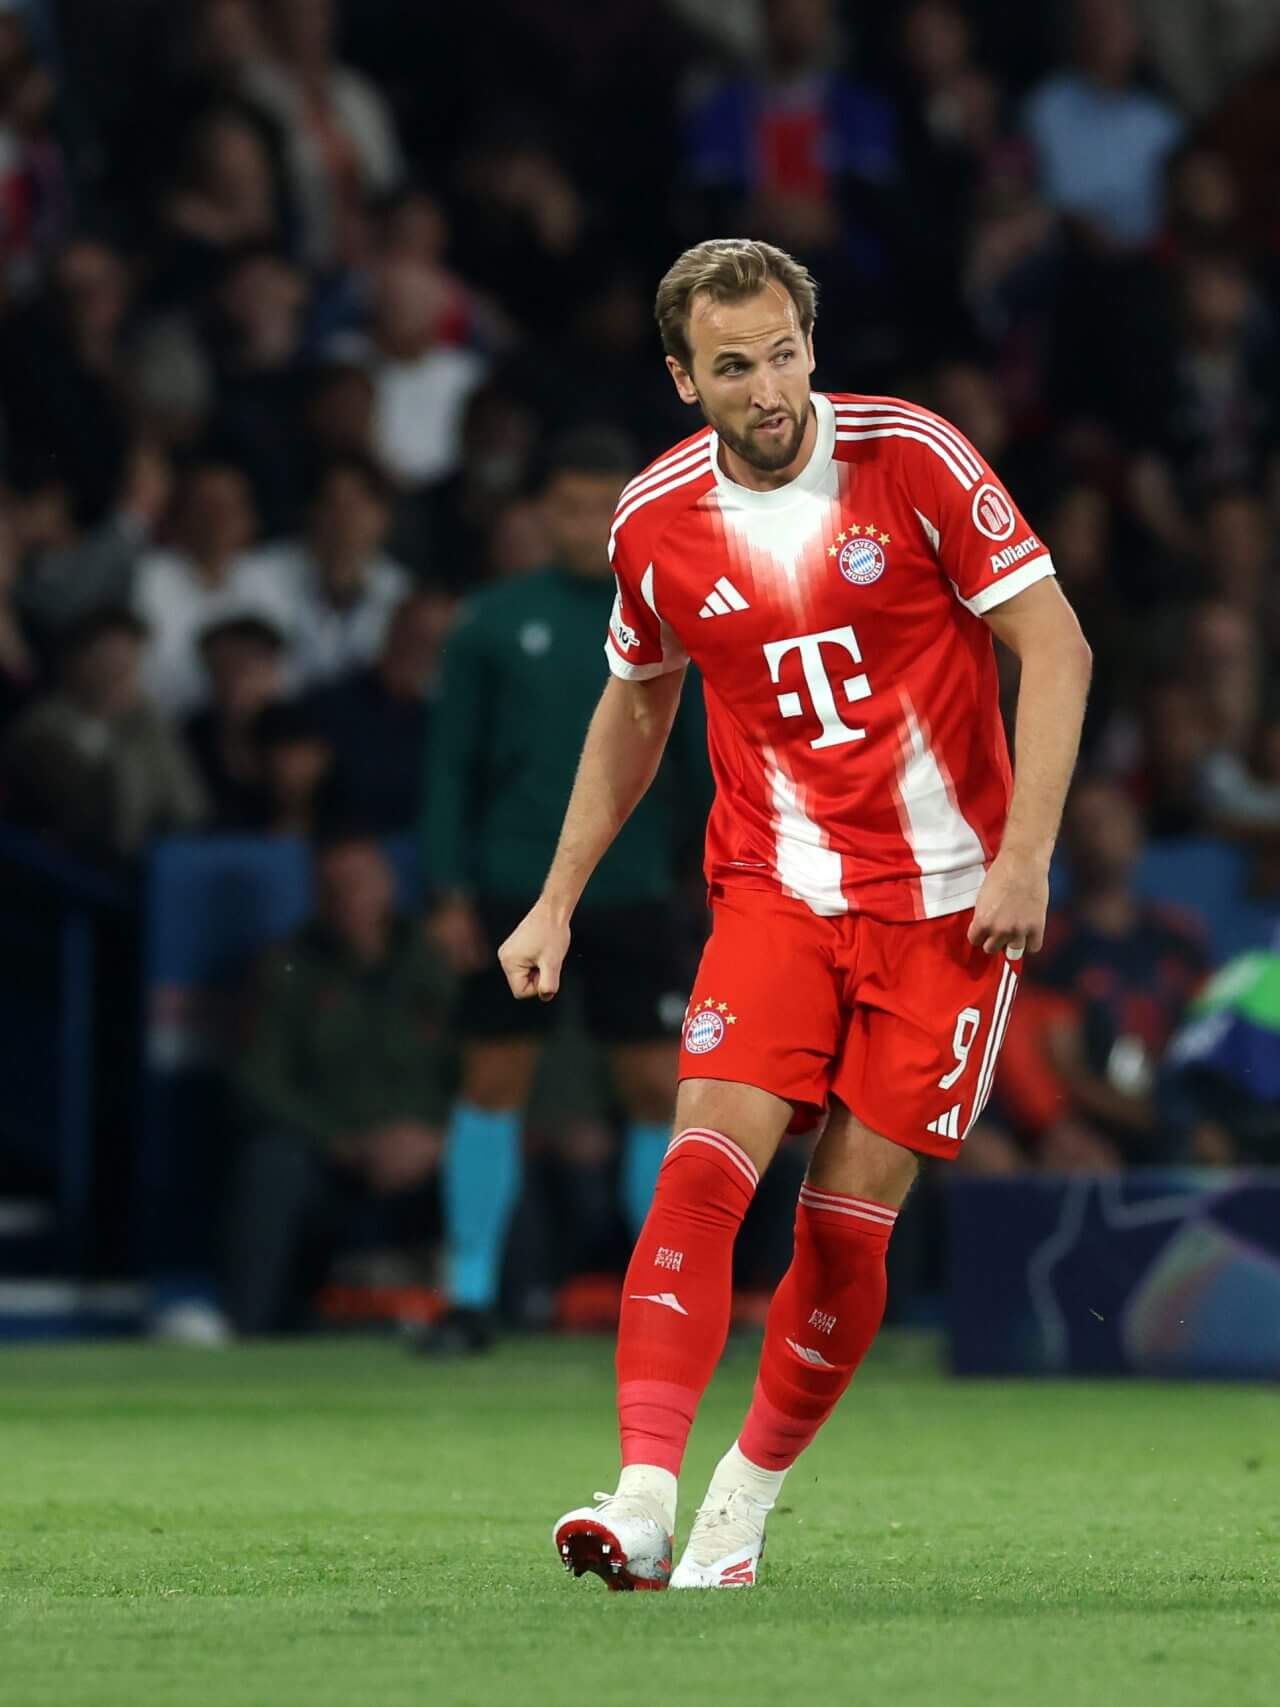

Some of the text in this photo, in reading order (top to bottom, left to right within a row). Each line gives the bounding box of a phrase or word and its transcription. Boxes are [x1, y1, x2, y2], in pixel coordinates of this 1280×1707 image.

[848, 541, 879, 556] BAYERN
[990, 536, 1040, 574] Allianz
[938, 1007, 981, 1090] 9
